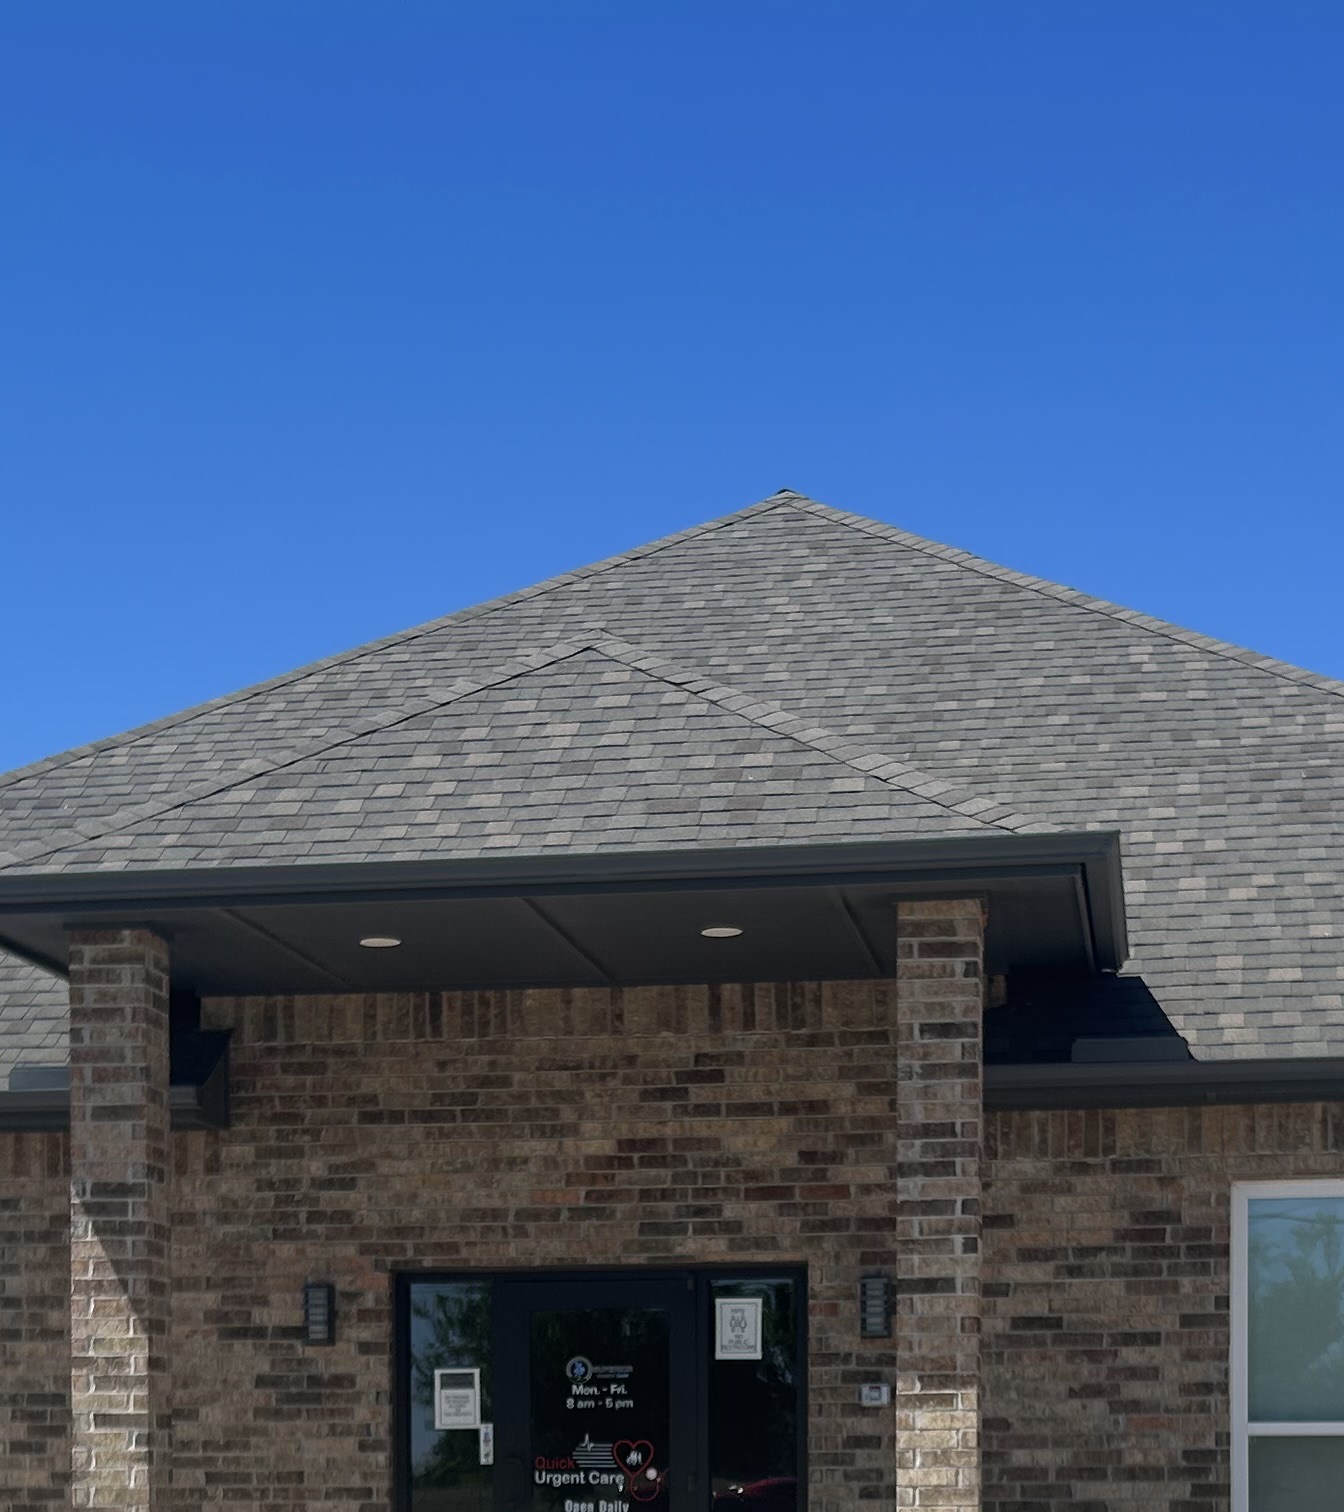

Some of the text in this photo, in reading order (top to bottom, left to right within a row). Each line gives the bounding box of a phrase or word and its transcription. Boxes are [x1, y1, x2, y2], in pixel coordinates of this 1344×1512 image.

[577, 1400, 595, 1409] am
[615, 1400, 634, 1410] pm
[535, 1456, 575, 1470] Quick
[534, 1470, 624, 1488] Urgent Care
